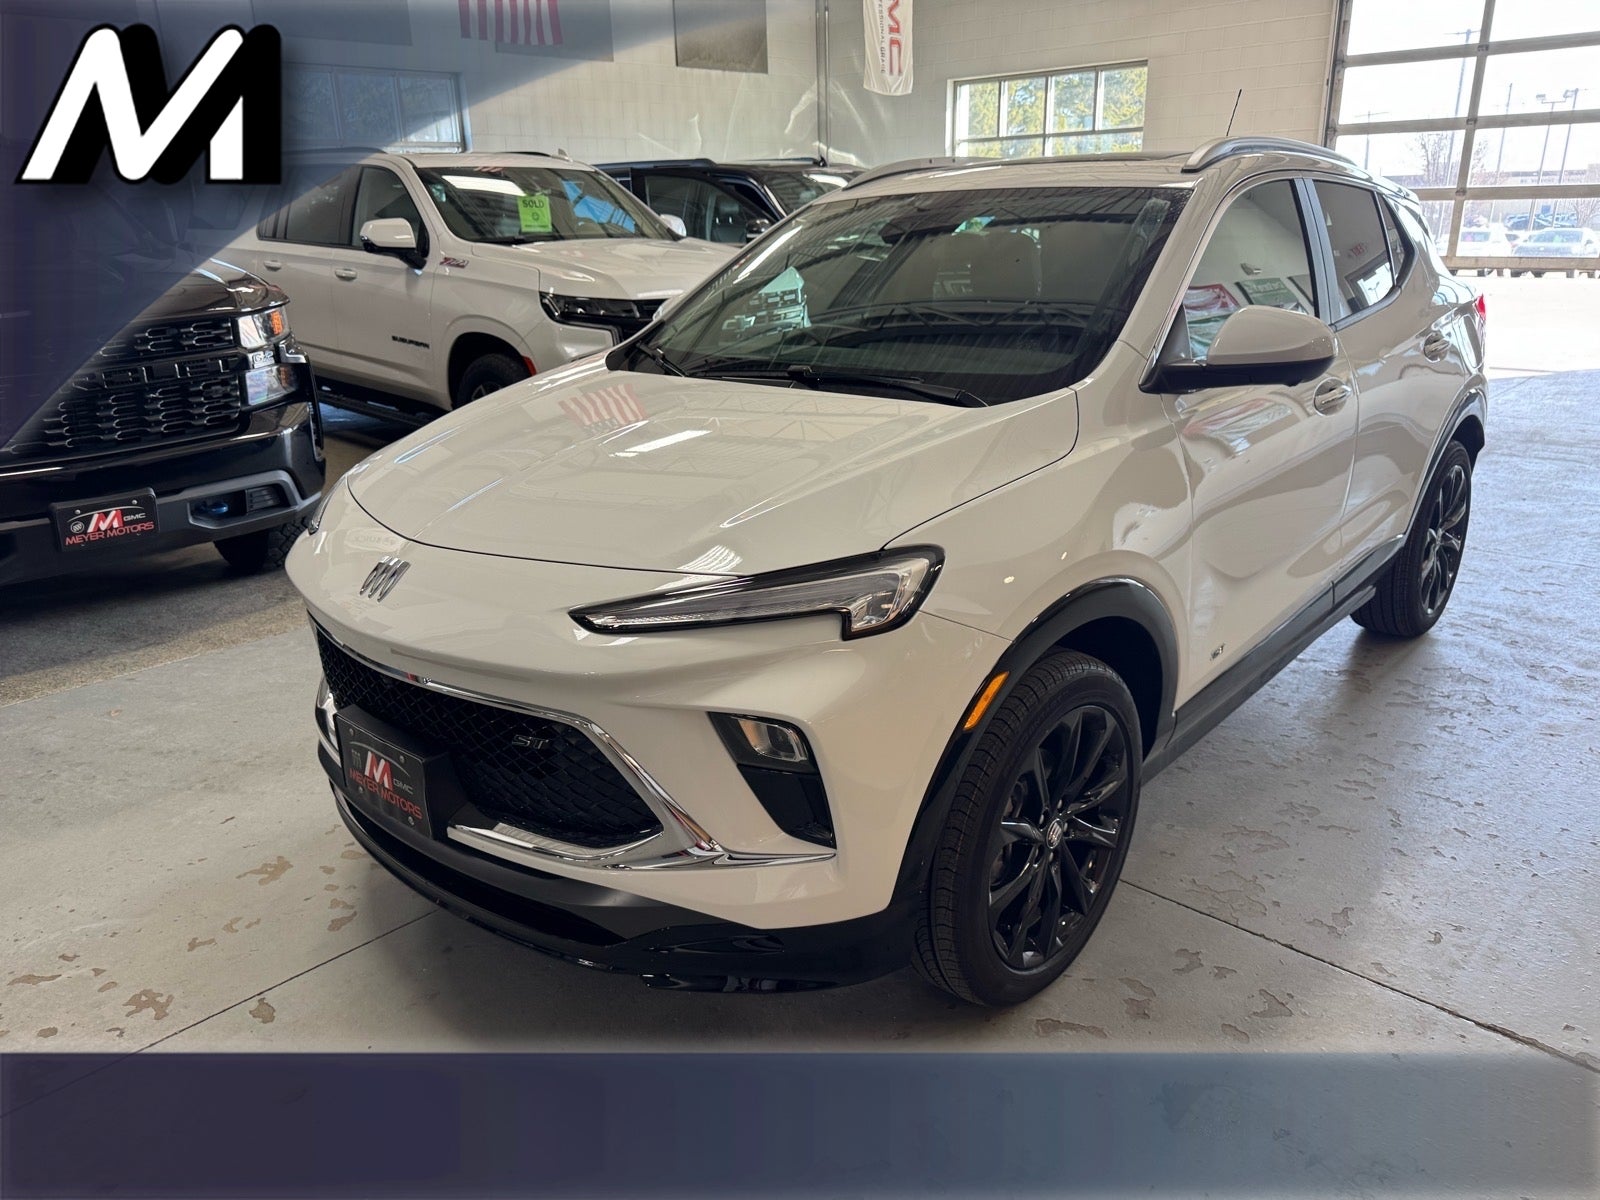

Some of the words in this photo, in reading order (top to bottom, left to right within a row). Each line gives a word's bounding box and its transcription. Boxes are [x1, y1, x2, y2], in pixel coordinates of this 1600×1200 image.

[888, 0, 903, 76] MC
[522, 199, 545, 209] SOLD
[123, 512, 146, 522] GMC
[65, 530, 105, 545] MEYER
[106, 521, 155, 538] MOTORS
[349, 767, 379, 793] MEYER
[381, 789, 423, 820] MOTORS
[393, 778, 414, 795] GMC
